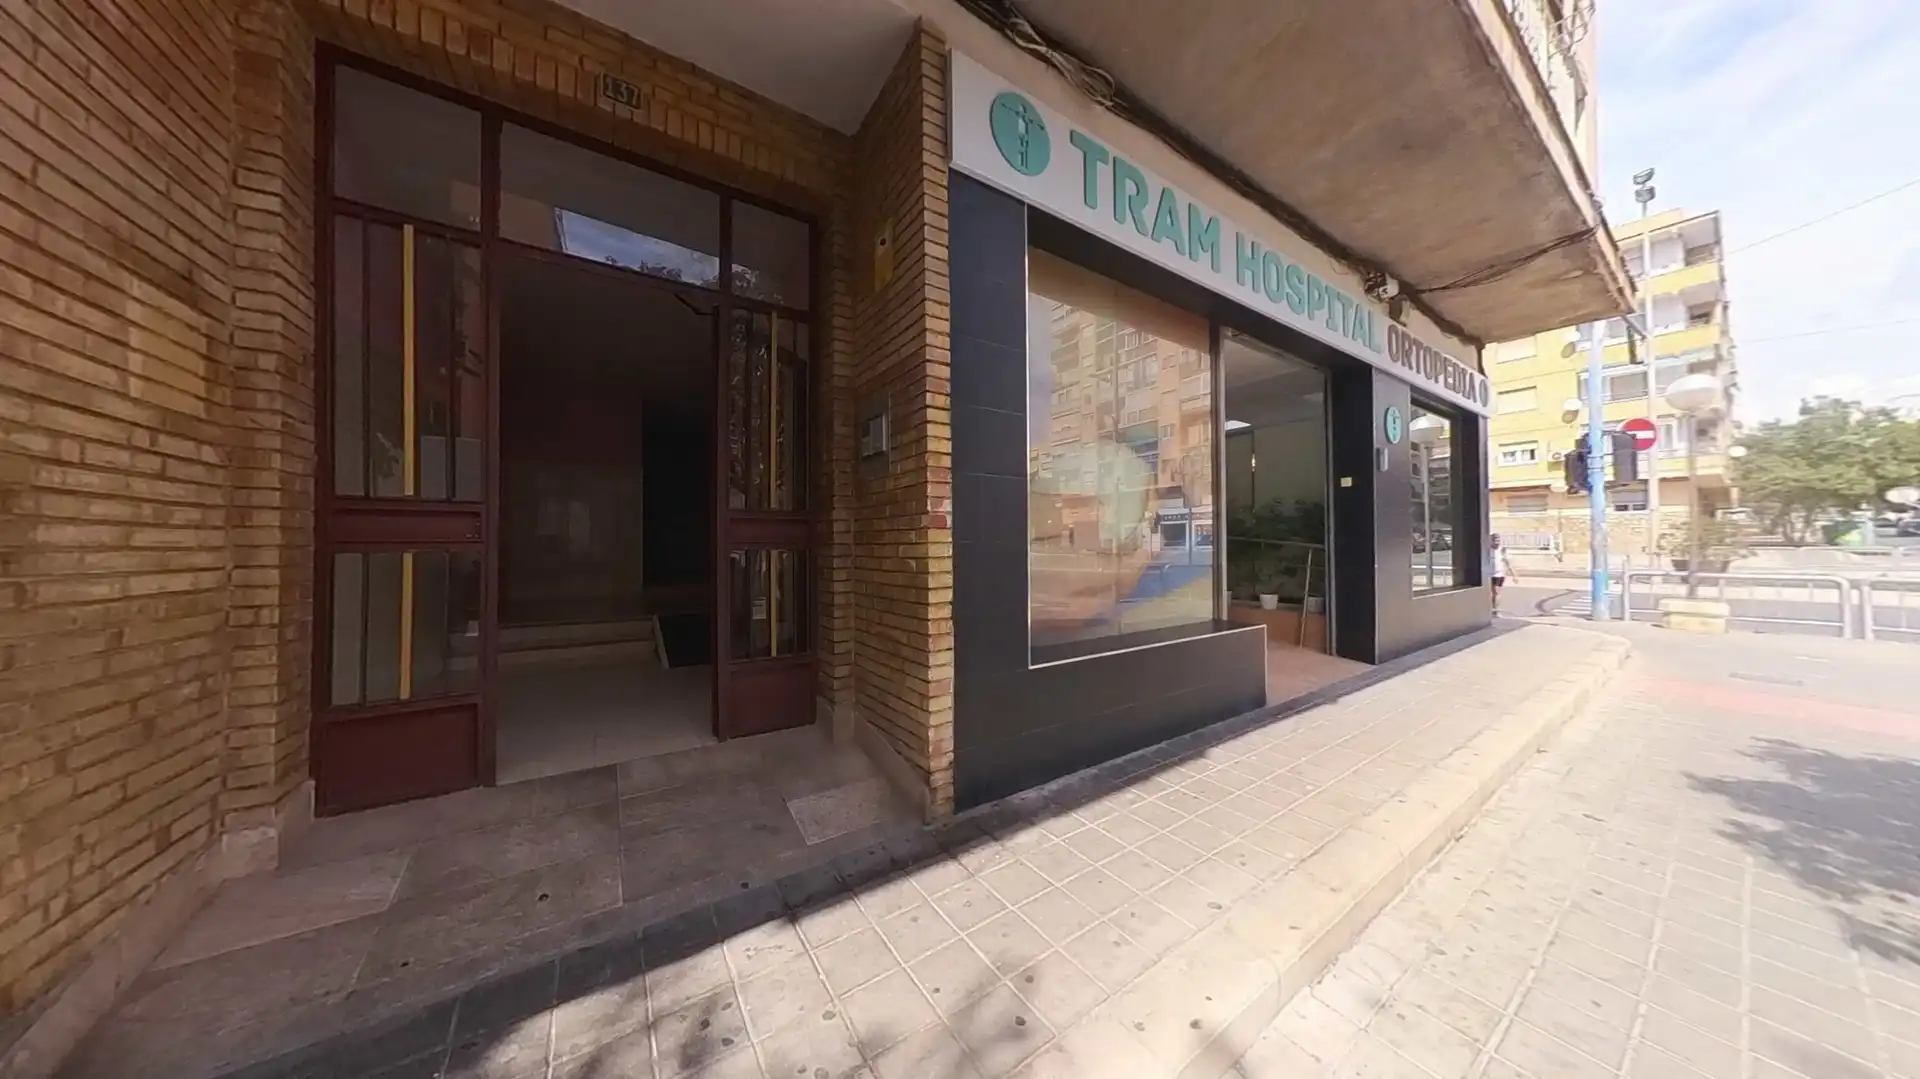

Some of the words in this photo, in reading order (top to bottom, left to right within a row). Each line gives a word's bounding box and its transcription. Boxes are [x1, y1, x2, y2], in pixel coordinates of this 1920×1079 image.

[1070, 130, 1221, 273] TRAM
[1236, 231, 1381, 354] HOSPITAL
[1387, 324, 1477, 404] ORTOPEDIA
